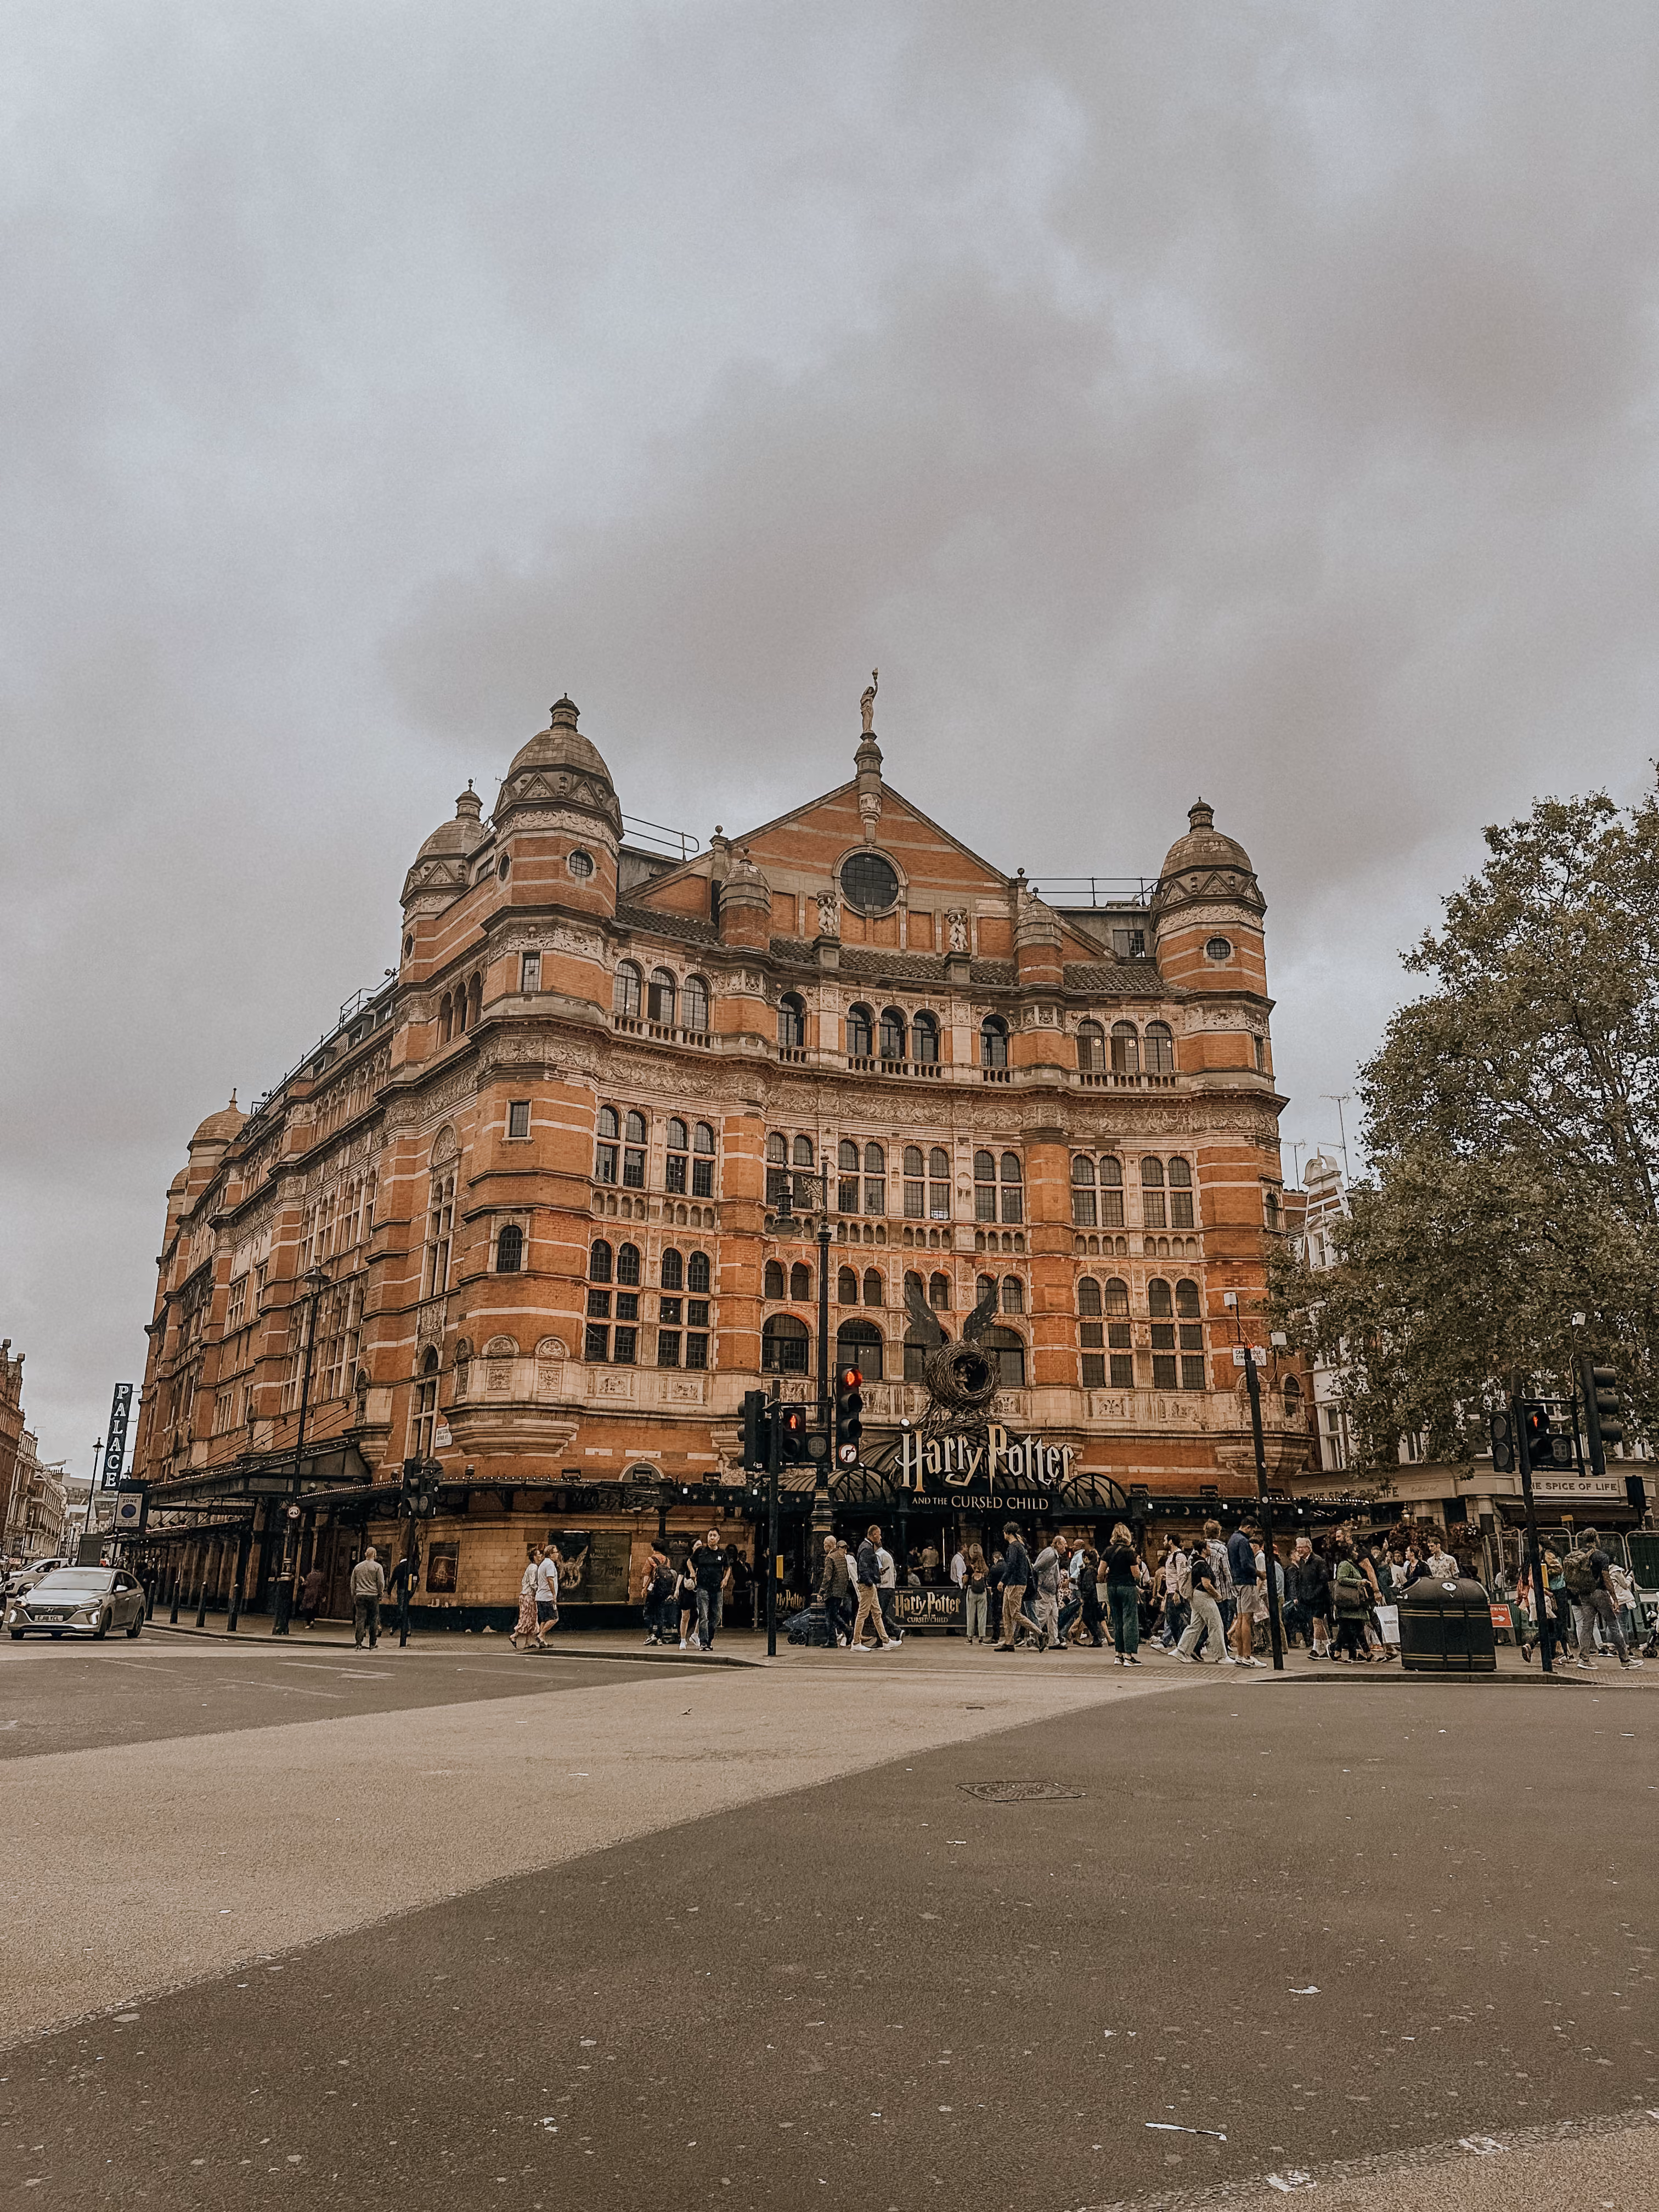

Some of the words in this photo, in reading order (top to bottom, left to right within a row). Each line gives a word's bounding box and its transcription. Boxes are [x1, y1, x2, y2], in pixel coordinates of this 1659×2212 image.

[104, 1385, 129, 1487] PALACE
[895, 1430, 984, 1492] Harry
[987, 1424, 1074, 1494] Potter
[1545, 1482, 1575, 1491] SPICE
[951, 1496, 1002, 1513] CURSED
[1007, 1497, 1048, 1510] CHILD
[786, 1589, 805, 1609] Potter
[893, 1594, 926, 1618] Harry
[927, 1592, 961, 1618] Potter
